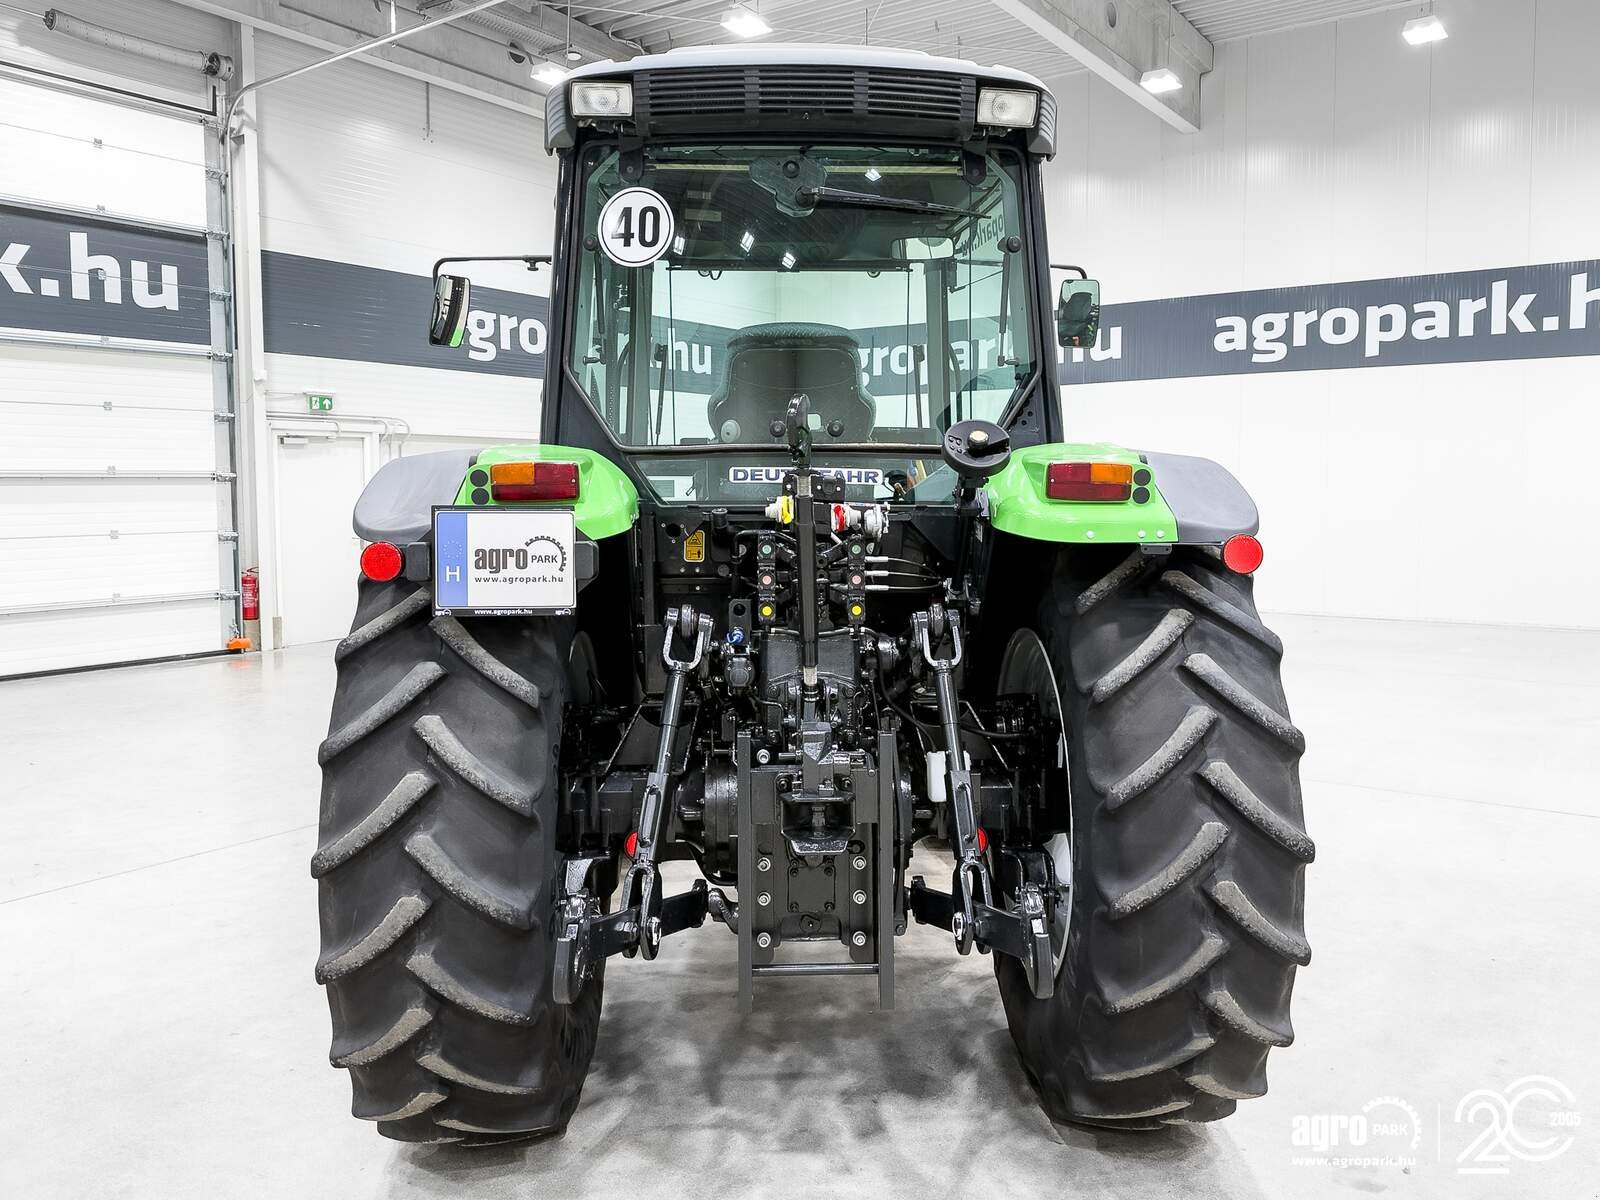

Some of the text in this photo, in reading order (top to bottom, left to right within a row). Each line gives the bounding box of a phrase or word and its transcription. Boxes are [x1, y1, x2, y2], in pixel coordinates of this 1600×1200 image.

[610, 205, 659, 248] 40
[462, 310, 547, 361] gro
[445, 565, 460, 582] H
[474, 548, 558, 574] agro PARK
[474, 575, 564, 585] www.agropark.hu
